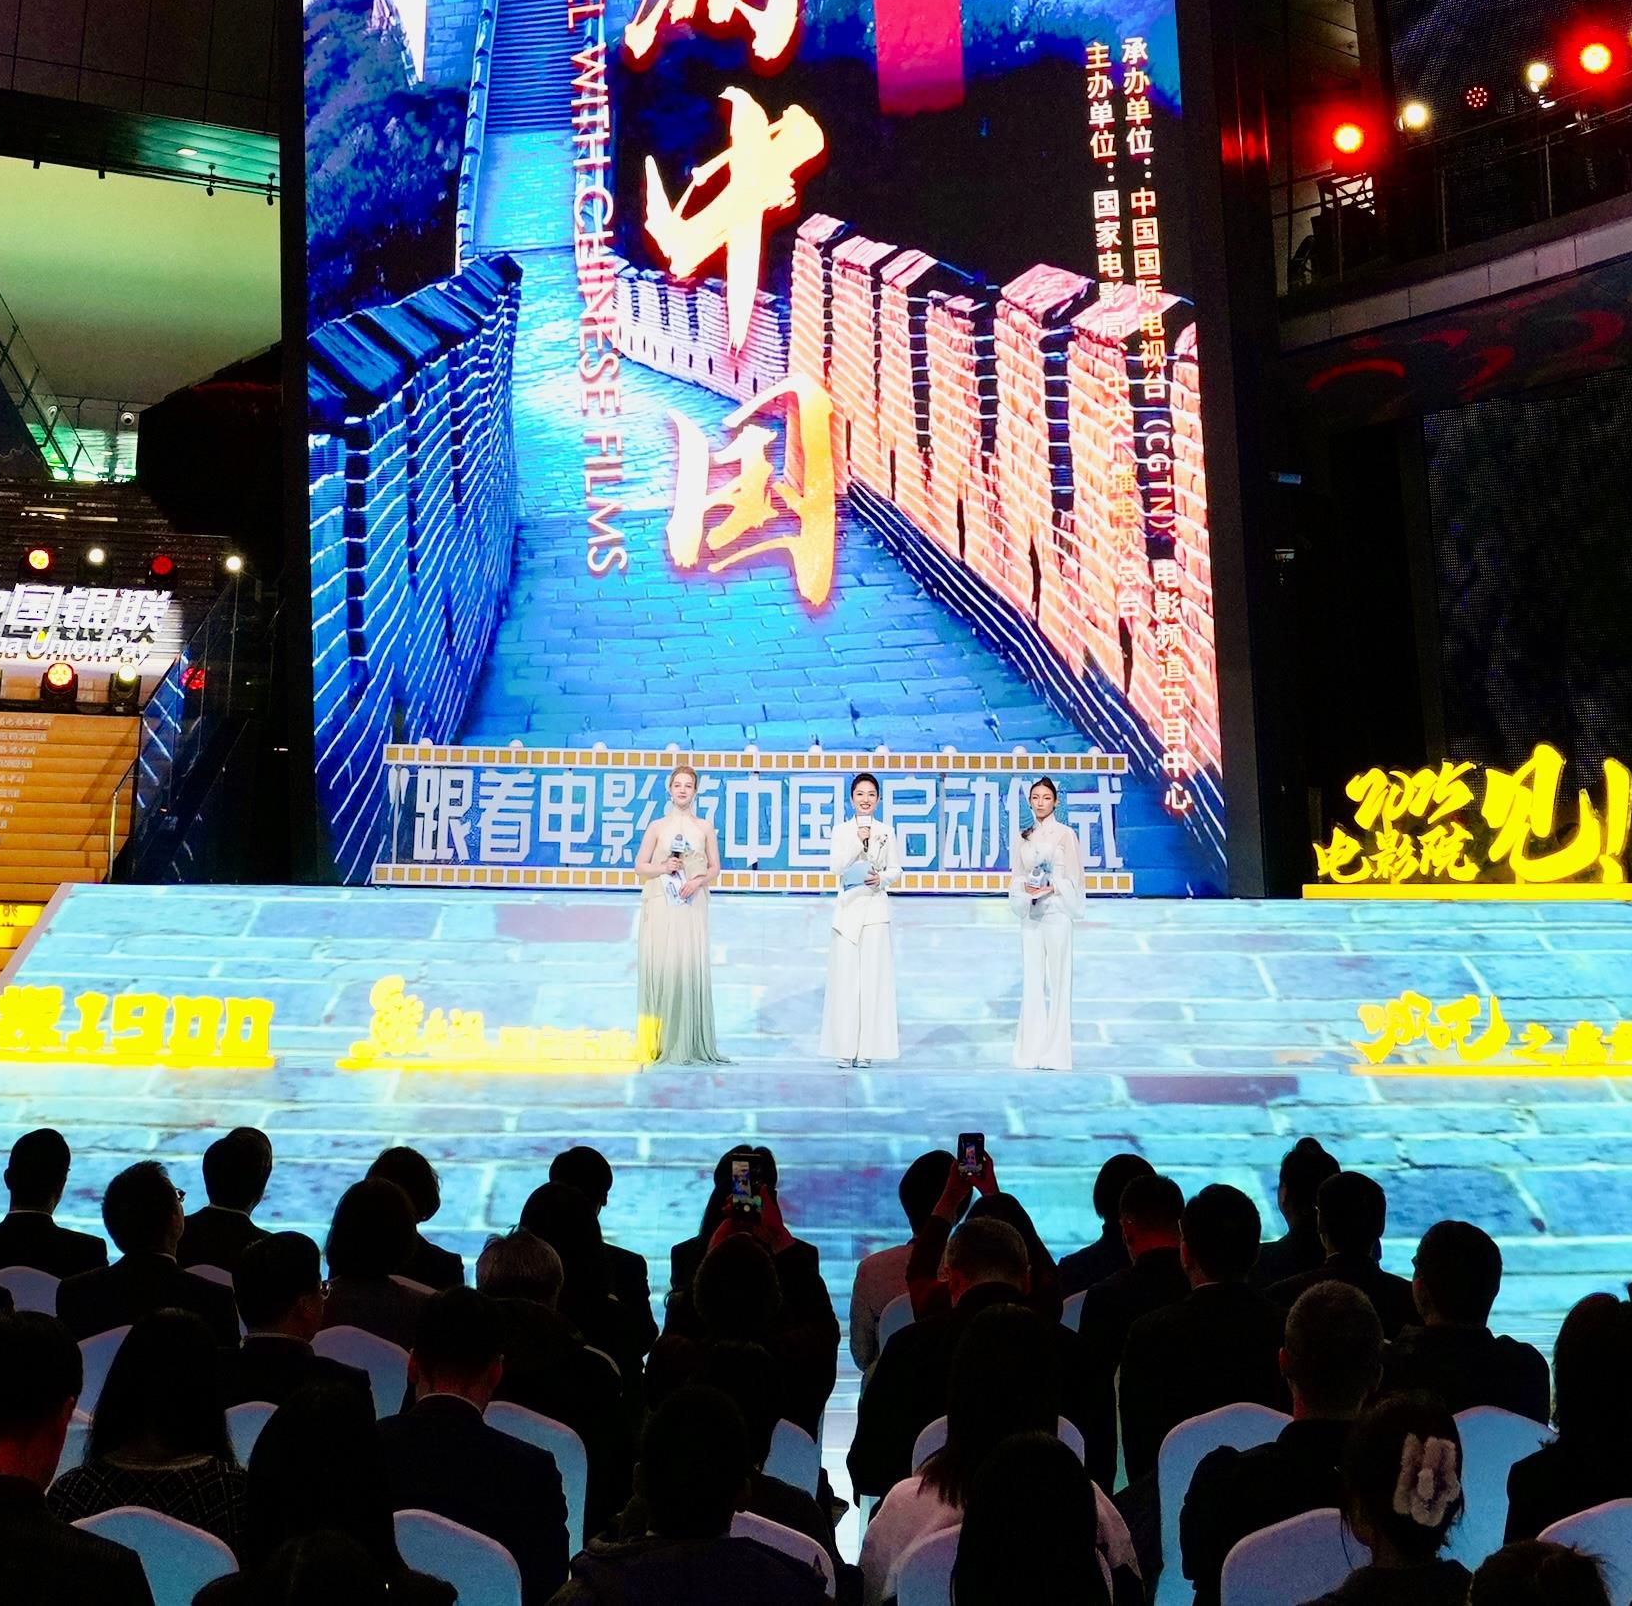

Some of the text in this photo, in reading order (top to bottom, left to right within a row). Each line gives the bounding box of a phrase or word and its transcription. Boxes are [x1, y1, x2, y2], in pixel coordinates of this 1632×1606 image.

[570, 42, 611, 167] WITH
[574, 185, 622, 412] CHINESE
[584, 430, 628, 575] FILMS
[28, 630, 155, 666] UnionPay
[1313, 826, 1481, 884] 电影院
